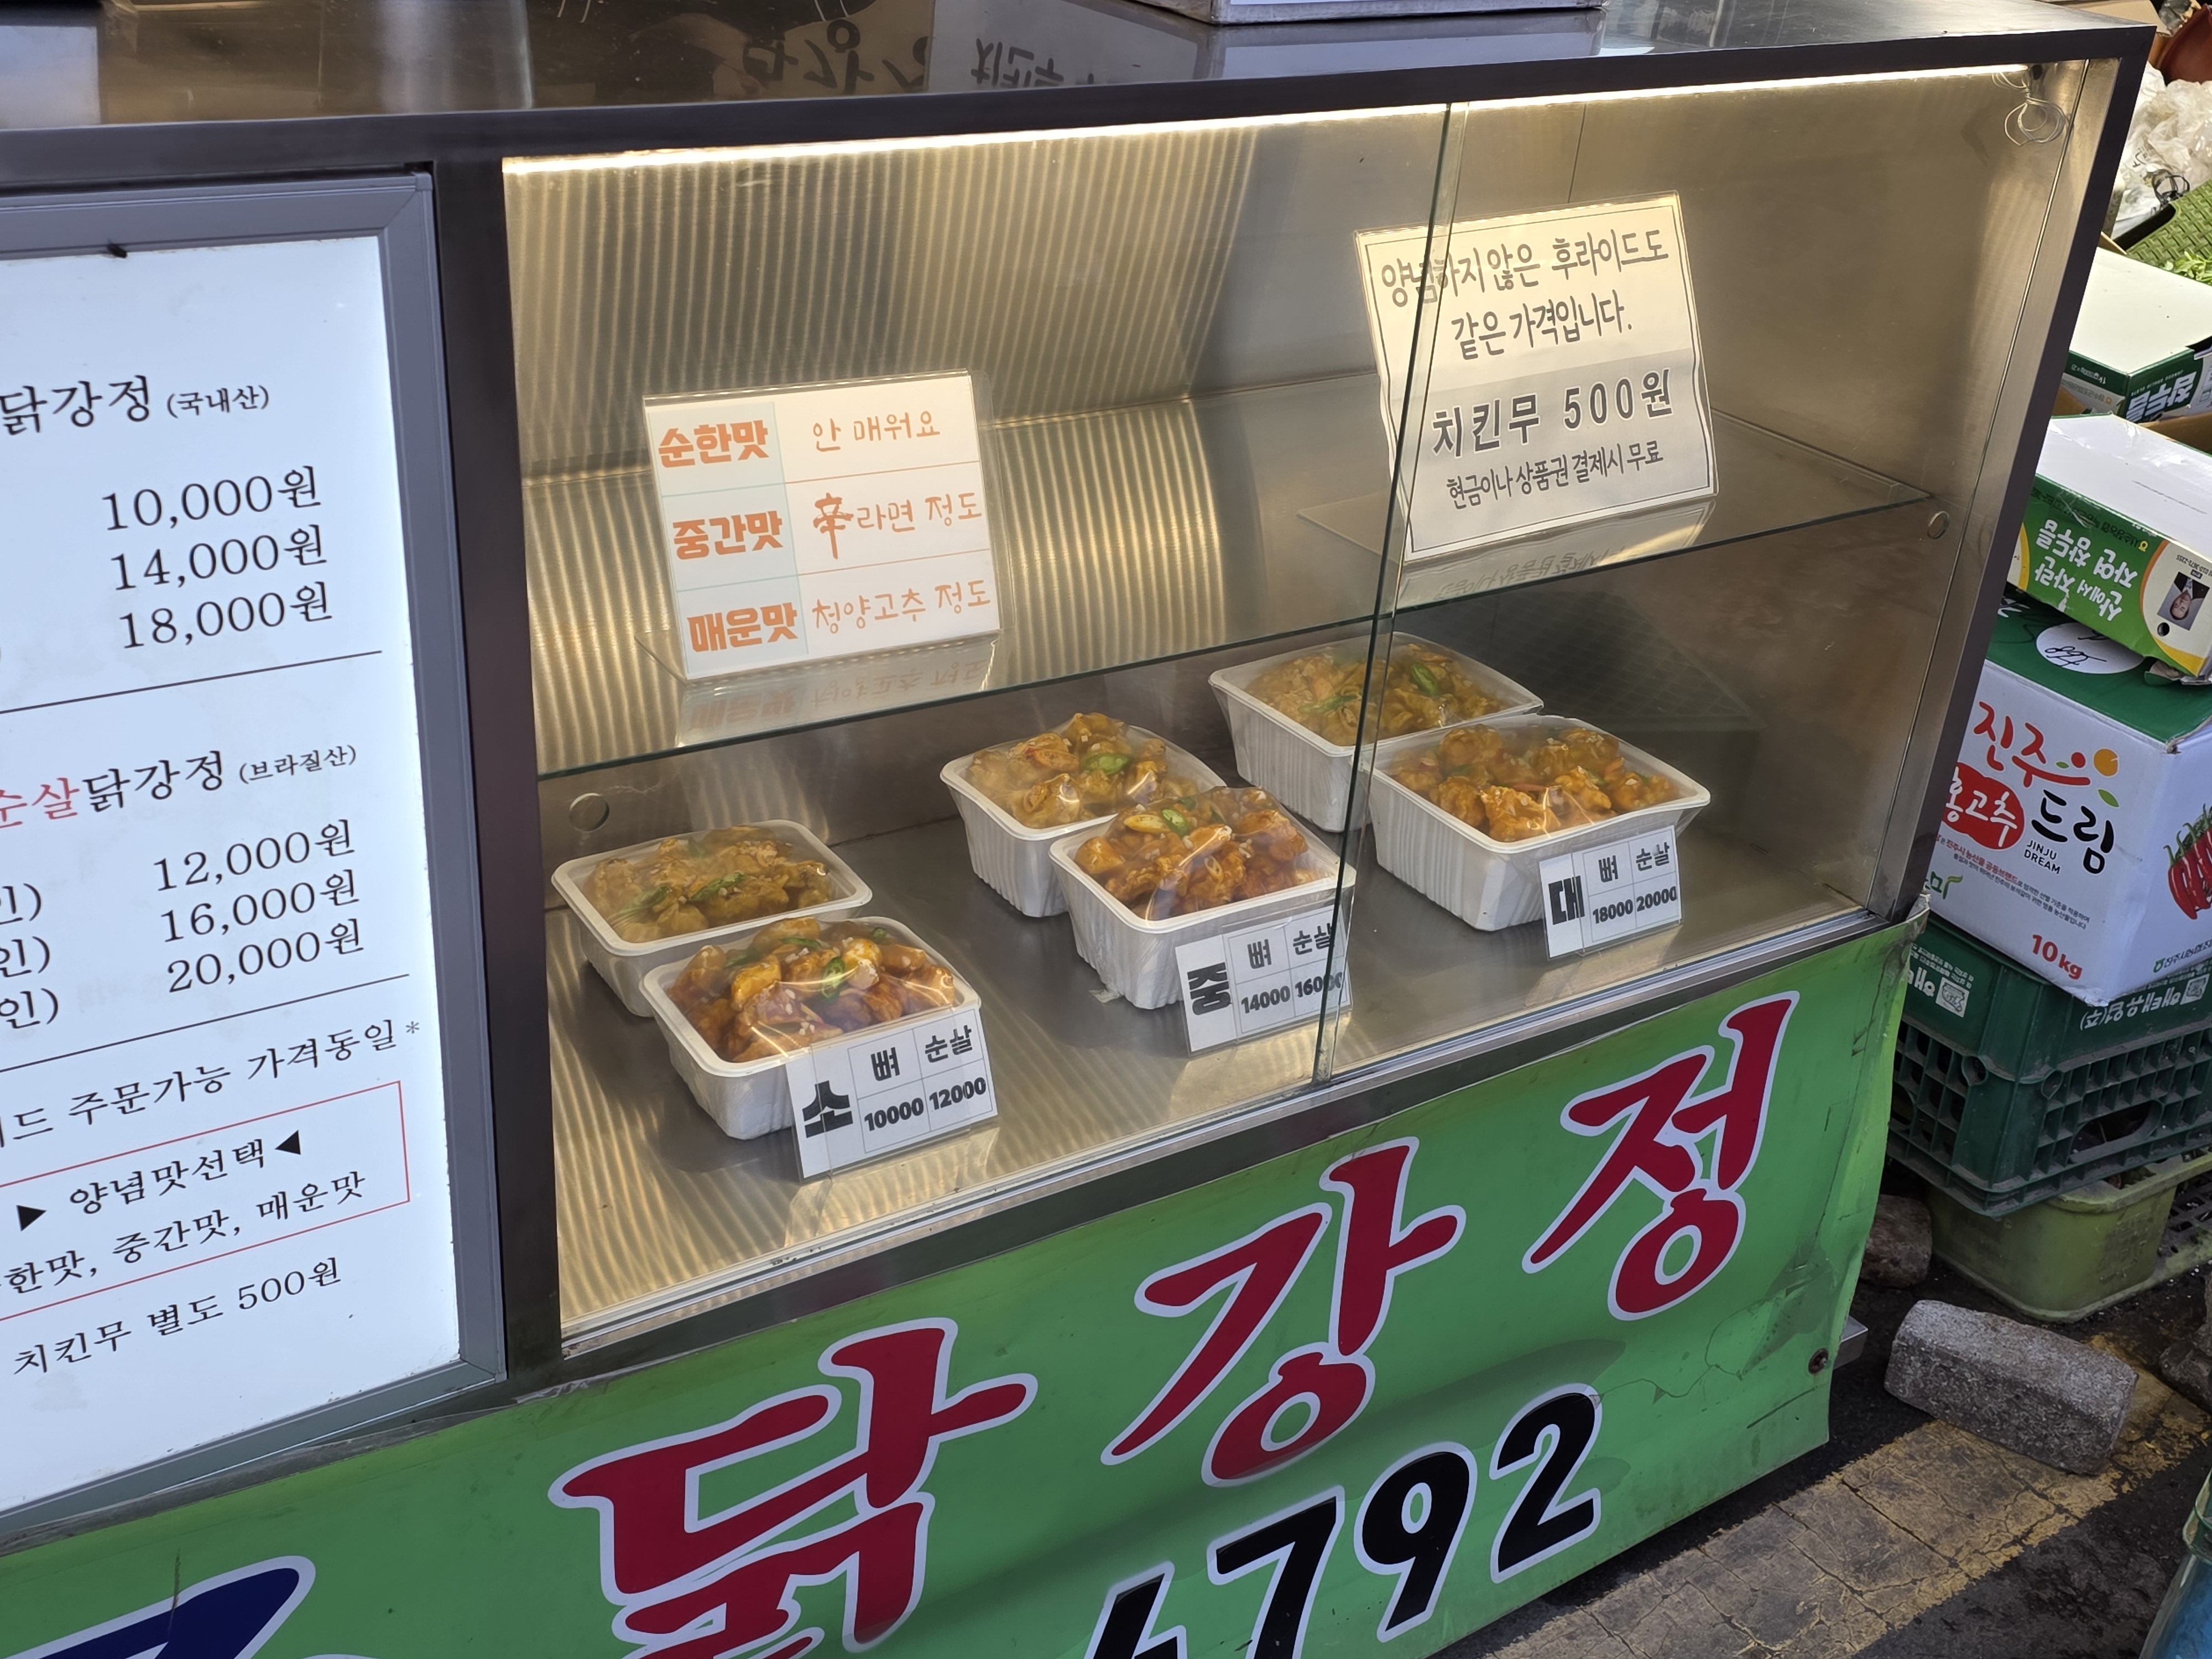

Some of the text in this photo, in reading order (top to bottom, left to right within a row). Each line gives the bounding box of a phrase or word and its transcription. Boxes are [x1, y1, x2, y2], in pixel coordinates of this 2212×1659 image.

[1487, 243, 1540, 290] 않은
[1551, 229, 1669, 281] 후라이드도
[1452, 289, 1633, 360] 같은 가격입니다.
[0, 374, 269, 436] 닭강정 (국내산)
[1432, 369, 1673, 458] 치킨무 500원
[658, 410, 940, 468] 순한맛 안 매워요
[102, 465, 322, 531] 10,000원
[1447, 441, 1663, 510] 현금이나 상품권 결제시 무료
[672, 492, 982, 561] 중간맛 辛라면 정도
[111, 524, 327, 591] 14,000원
[2034, 556, 2075, 594] 자란
[2093, 549, 2138, 588] 자연
[119, 581, 332, 649] 18,000원
[687, 580, 991, 653] 매운맛 청양고추 정도
[2077, 579, 2122, 622] 산에서
[239, 745, 356, 785] (브라질산)
[1974, 701, 2090, 787] 진주
[1946, 766, 2017, 847] 홍고추
[2031, 789, 2114, 874] 드림
[154, 819, 355, 891] 12,000원
[1598, 842, 1670, 883] 뼈 순살
[1946, 839, 1966, 855] 진주시
[2024, 849, 2060, 875] DREAM
[2027, 840, 2057, 860] JINJU
[160, 869, 359, 942] 16,000원
[1548, 875, 1585, 925] 대
[1593, 886, 1677, 924] 18000 20000
[167, 919, 364, 993] 20,000원
[1247, 939, 1272, 969] 뼈
[2031, 932, 2083, 982] 10kg
[1187, 962, 1232, 1015] 중
[1241, 986, 1290, 1014] 14000
[2080, 987, 2181, 1031] 해태유업(주)
[69, 1066, 231, 1126] 주문가능
[248, 1019, 397, 1080] 가격동일
[870, 1024, 973, 1081] 뼈 순살
[802, 1080, 853, 1138] 소
[864, 1077, 986, 1131] 10000 12000
[69, 1138, 264, 1215] 양념맛선택
[0, 1171, 367, 1295] 한맛, 중간맛, 매운맛
[14, 1256, 341, 1375] 치킨무 별도 500원
